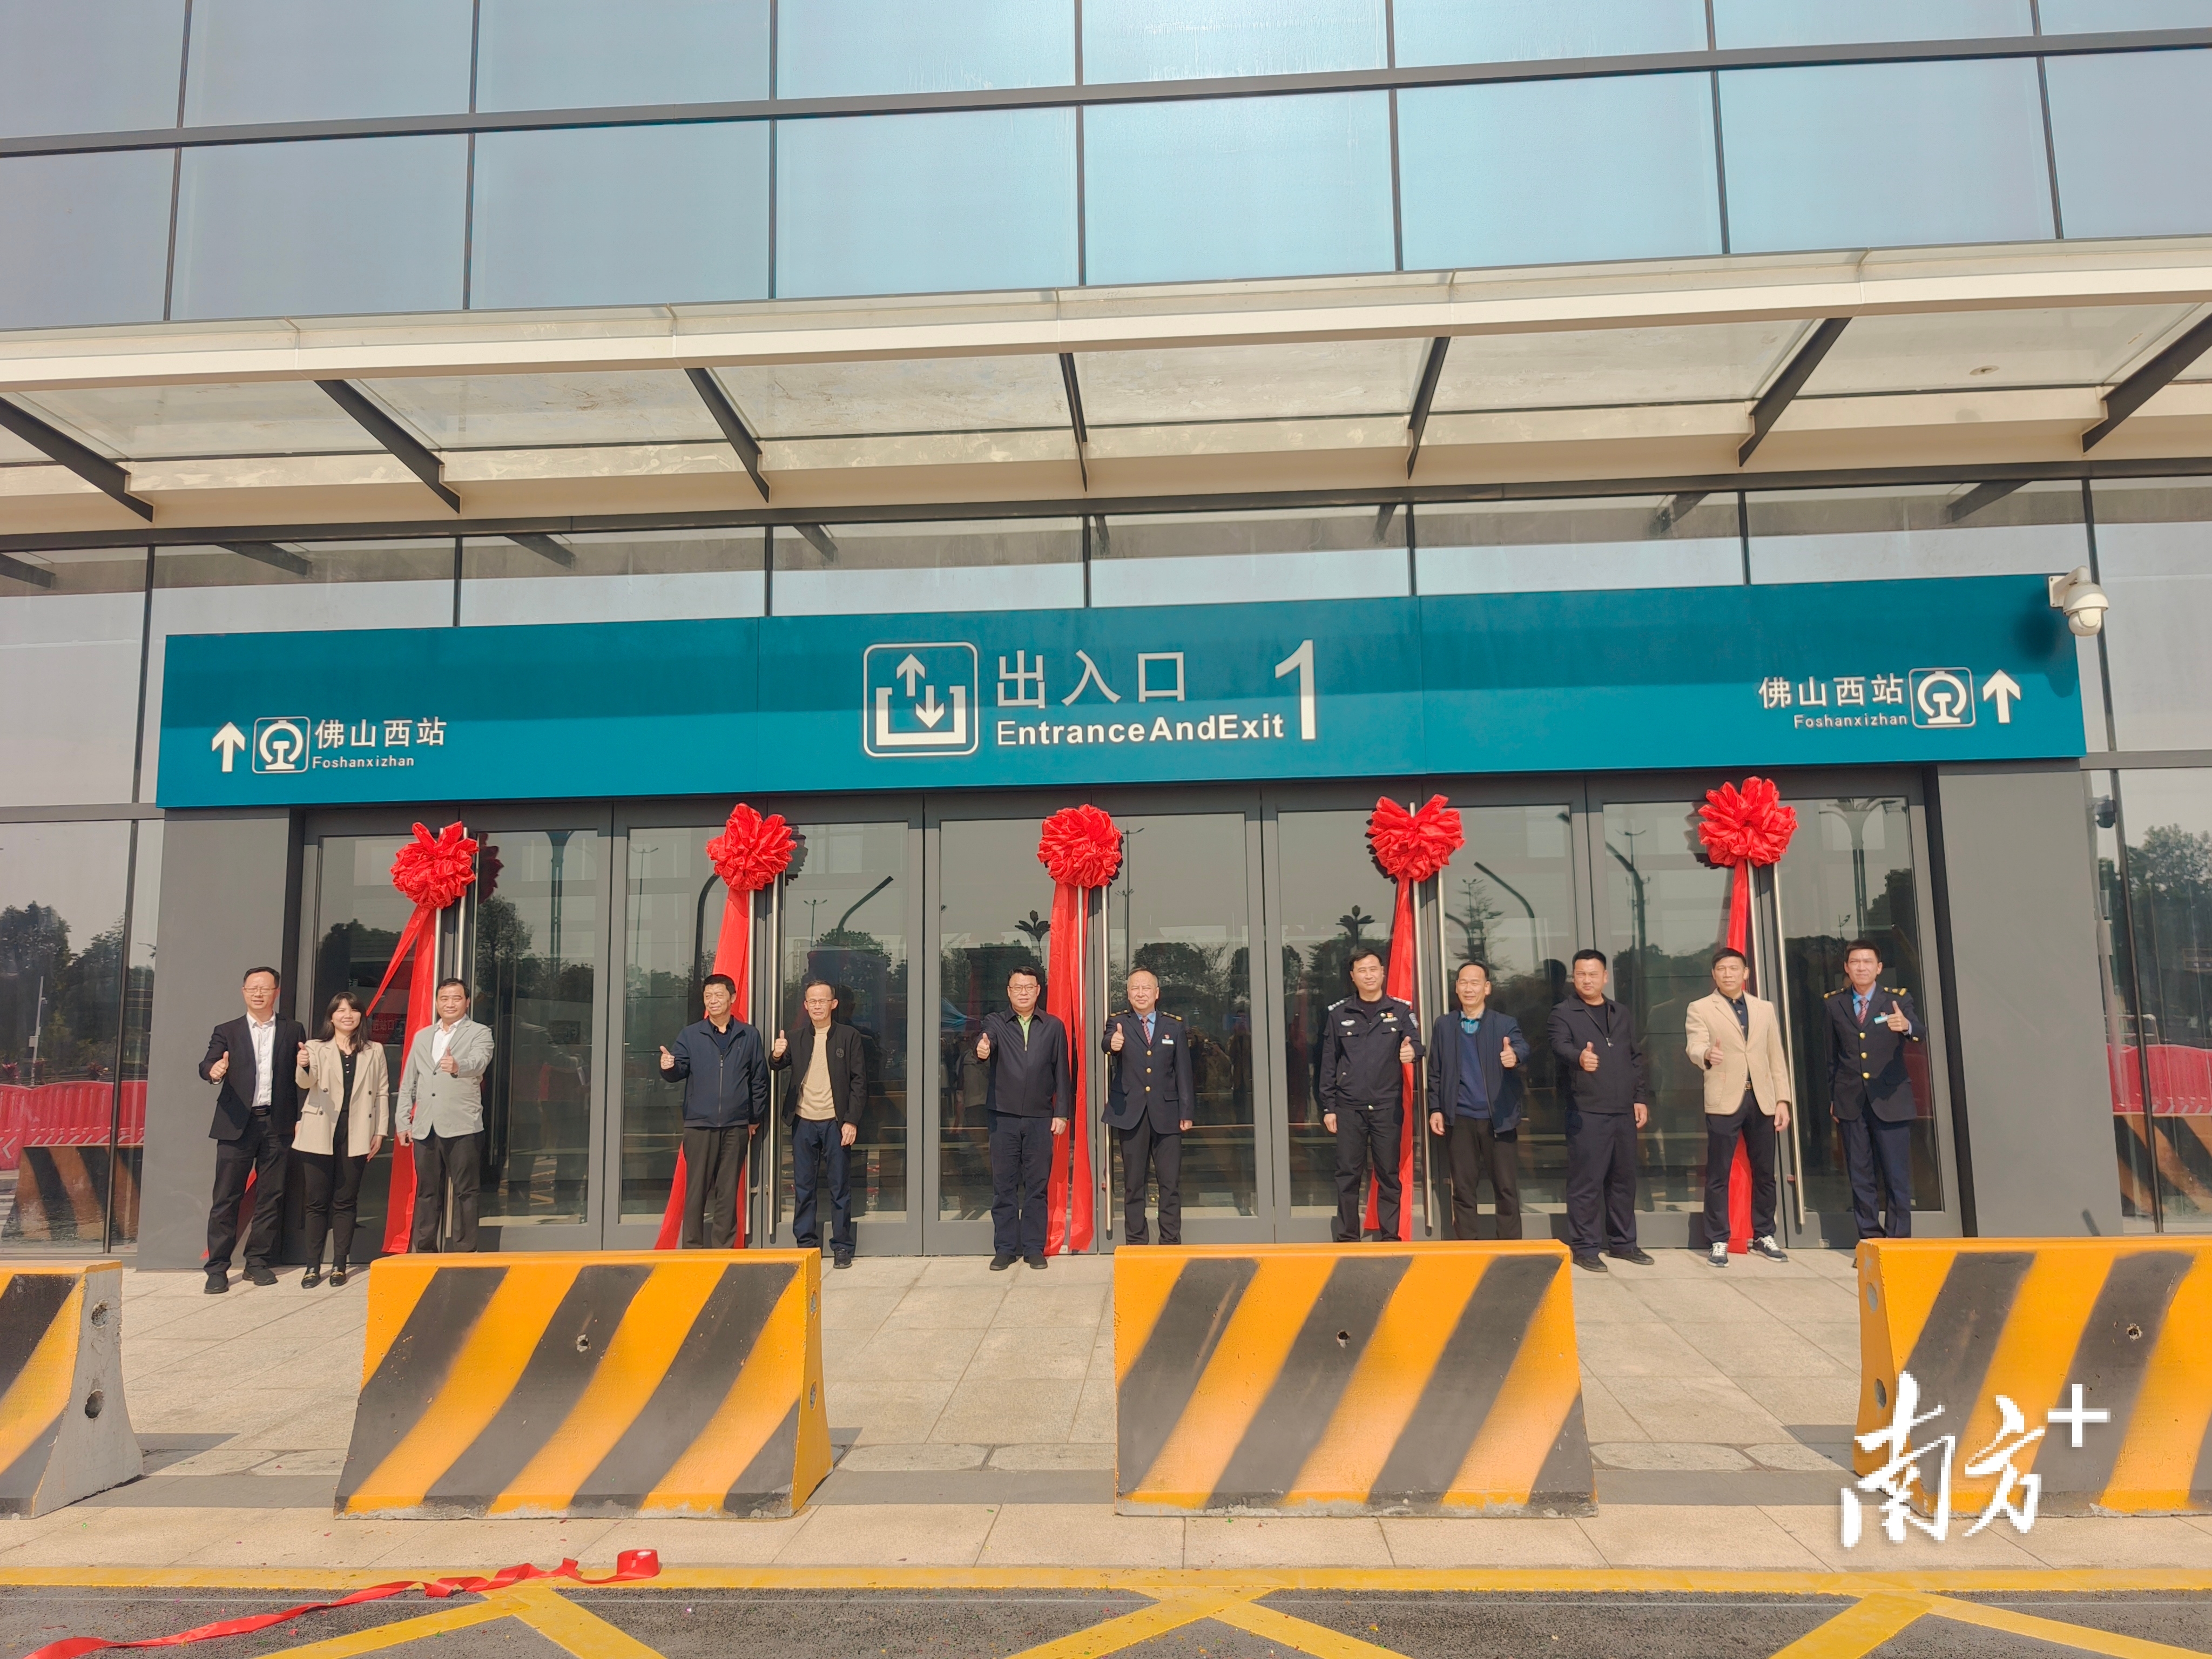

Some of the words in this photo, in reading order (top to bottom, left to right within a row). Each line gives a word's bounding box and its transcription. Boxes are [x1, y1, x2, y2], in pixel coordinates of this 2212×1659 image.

[997, 649, 1185, 709] 出入口
[1273, 639, 1317, 741] 1
[1758, 673, 1904, 709] 佛山西站
[314, 716, 447, 750] 佛山西站
[997, 713, 1284, 745] EntranceAndExit
[1793, 713, 1908, 729] Foshanxizhan
[312, 755, 415, 769] Foshanxizhan
